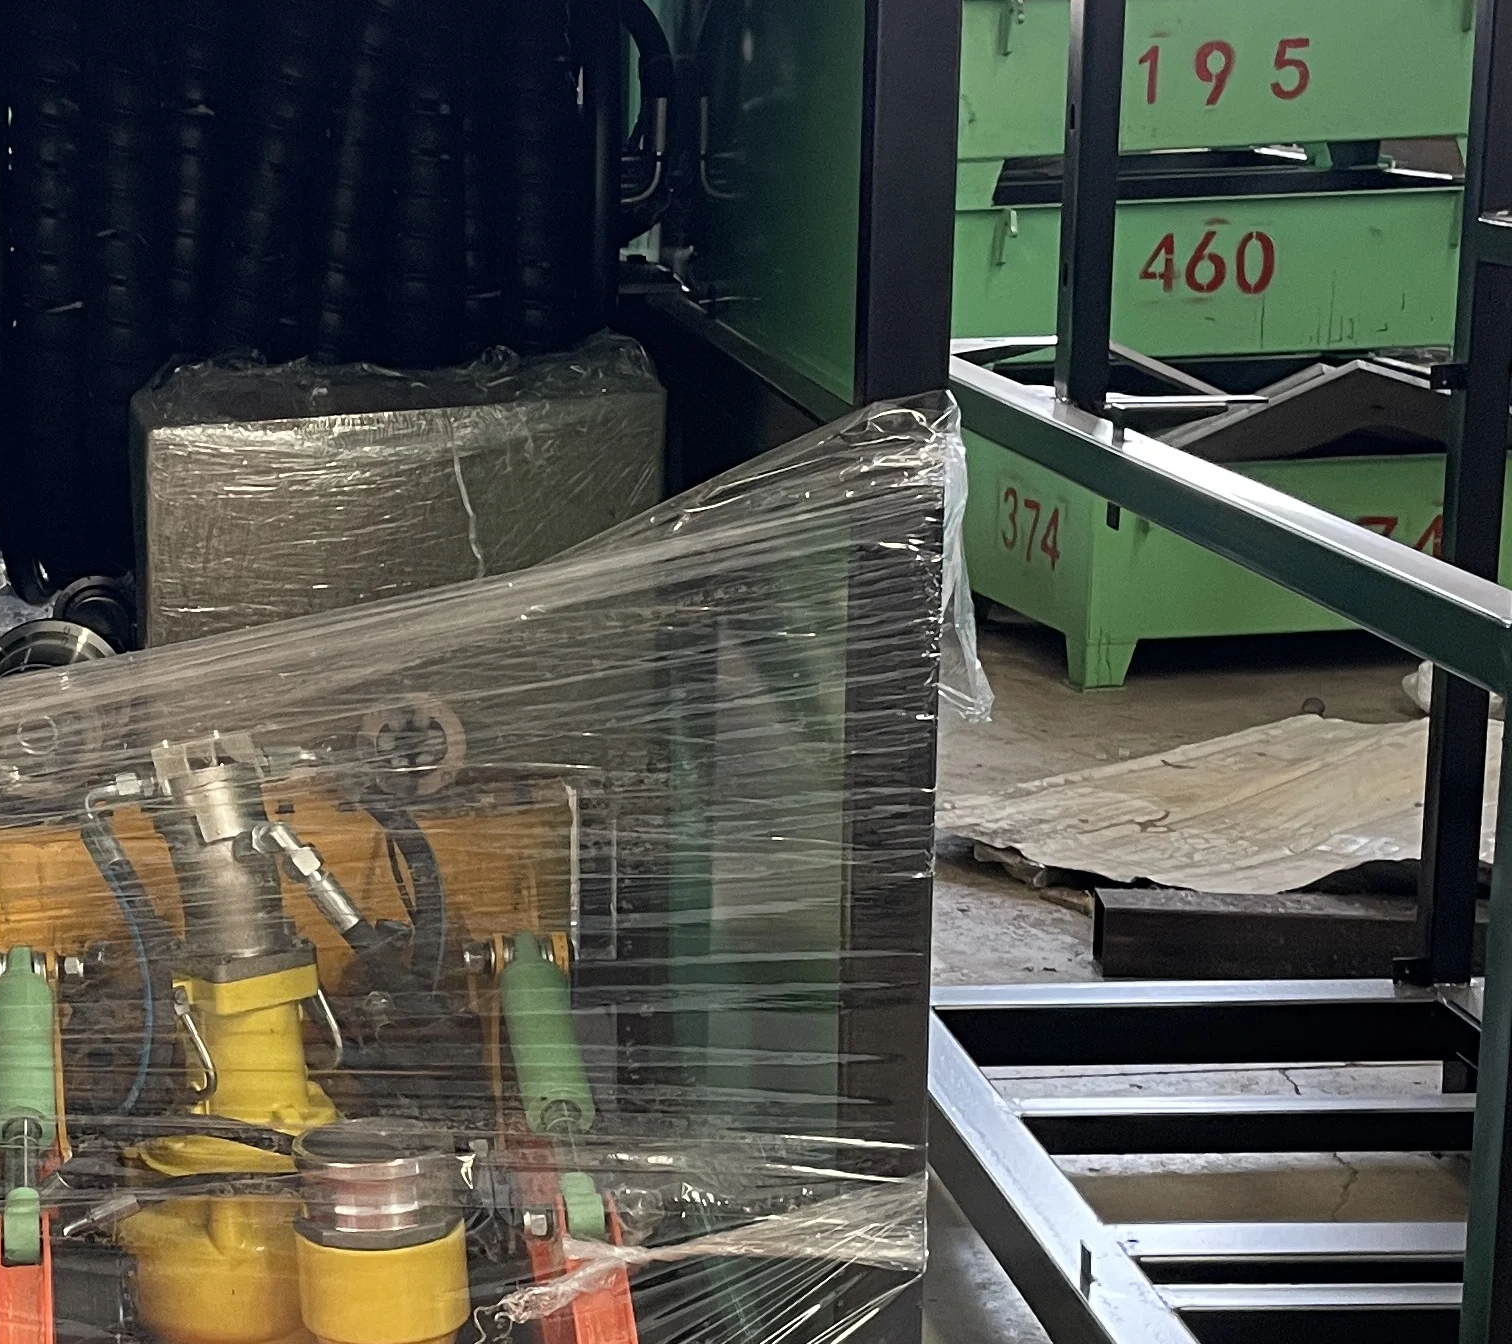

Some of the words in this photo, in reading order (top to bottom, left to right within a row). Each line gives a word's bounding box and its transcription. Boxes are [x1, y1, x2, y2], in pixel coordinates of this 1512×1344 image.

[1138, 37, 1310, 105] 195
[1139, 230, 1275, 294] 460
[1001, 487, 1060, 571] 374
